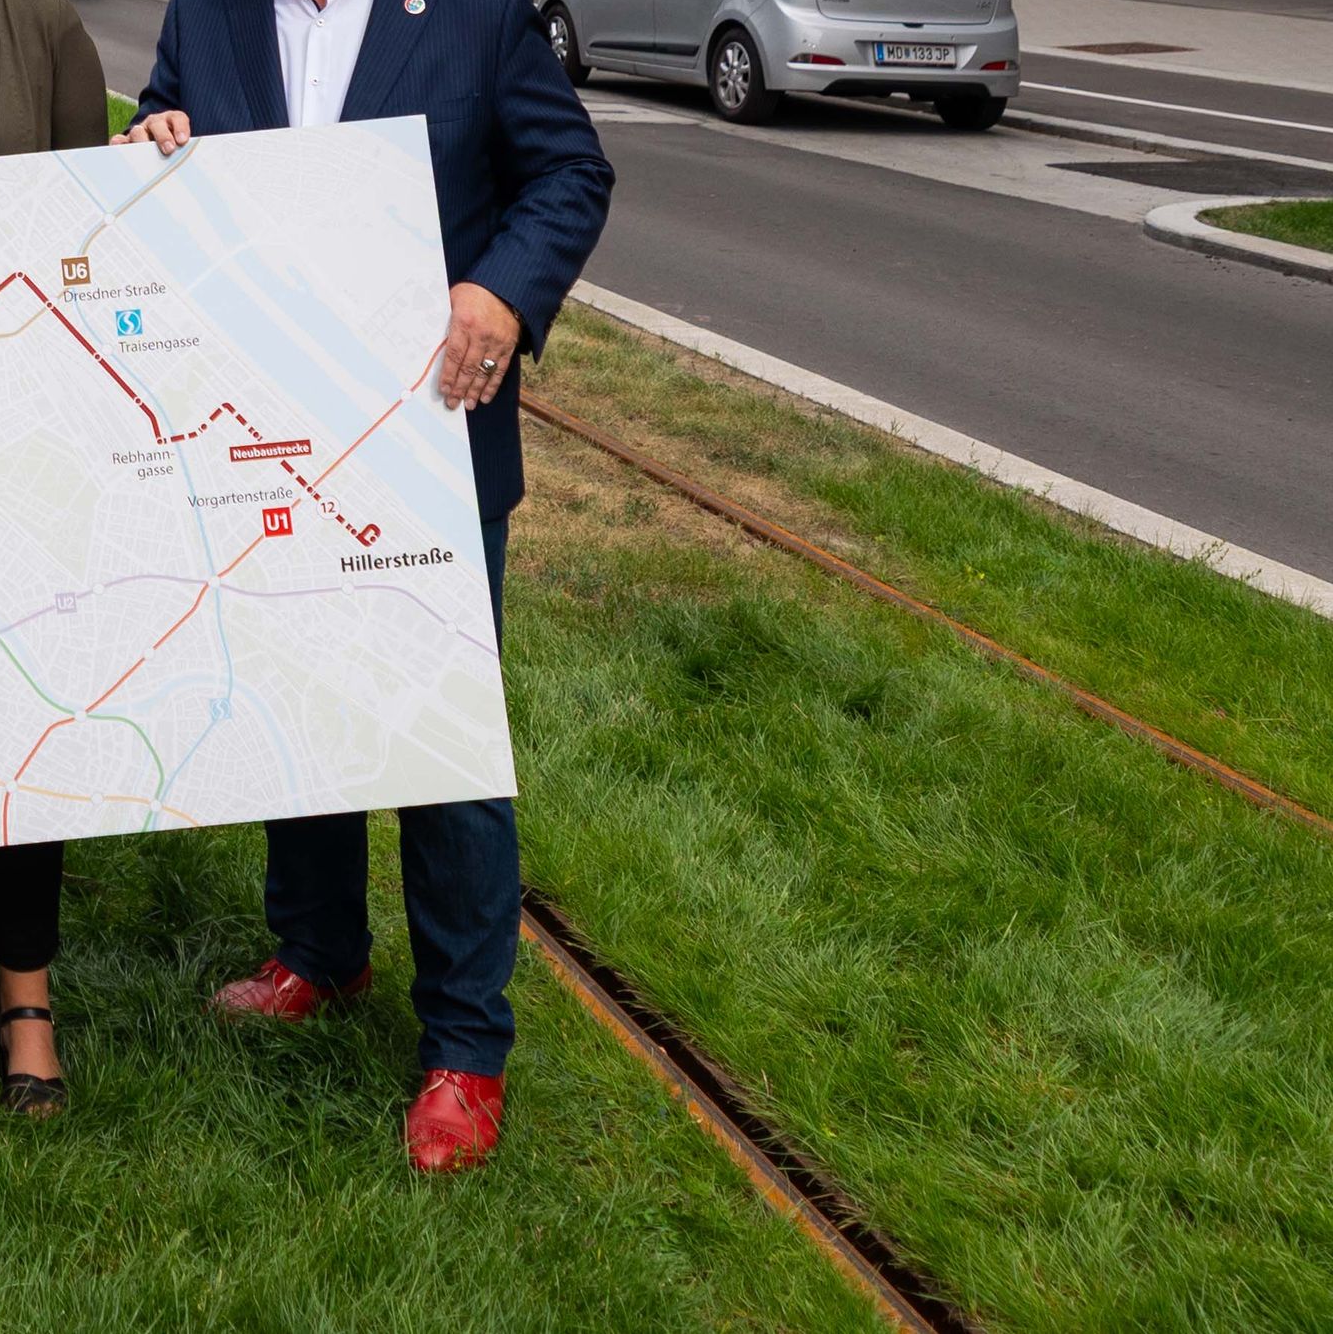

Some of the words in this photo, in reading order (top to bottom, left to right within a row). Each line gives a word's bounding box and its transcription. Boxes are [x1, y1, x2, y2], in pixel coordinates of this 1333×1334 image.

[63, 262, 88, 280] U6
[63, 288, 122, 304] Dresdner
[125, 281, 166, 298] Straße
[119, 336, 200, 354] Traisengasse
[112, 449, 175, 465] Rebhann-
[232, 442, 310, 460] Neubaustrecke
[137, 464, 174, 480] gasse
[187, 486, 293, 510] Vorgartenstraße
[320, 500, 336, 514] 12
[266, 512, 290, 532] U1
[340, 548, 454, 573] Hillerstraße
[56, 597, 75, 611] U2
